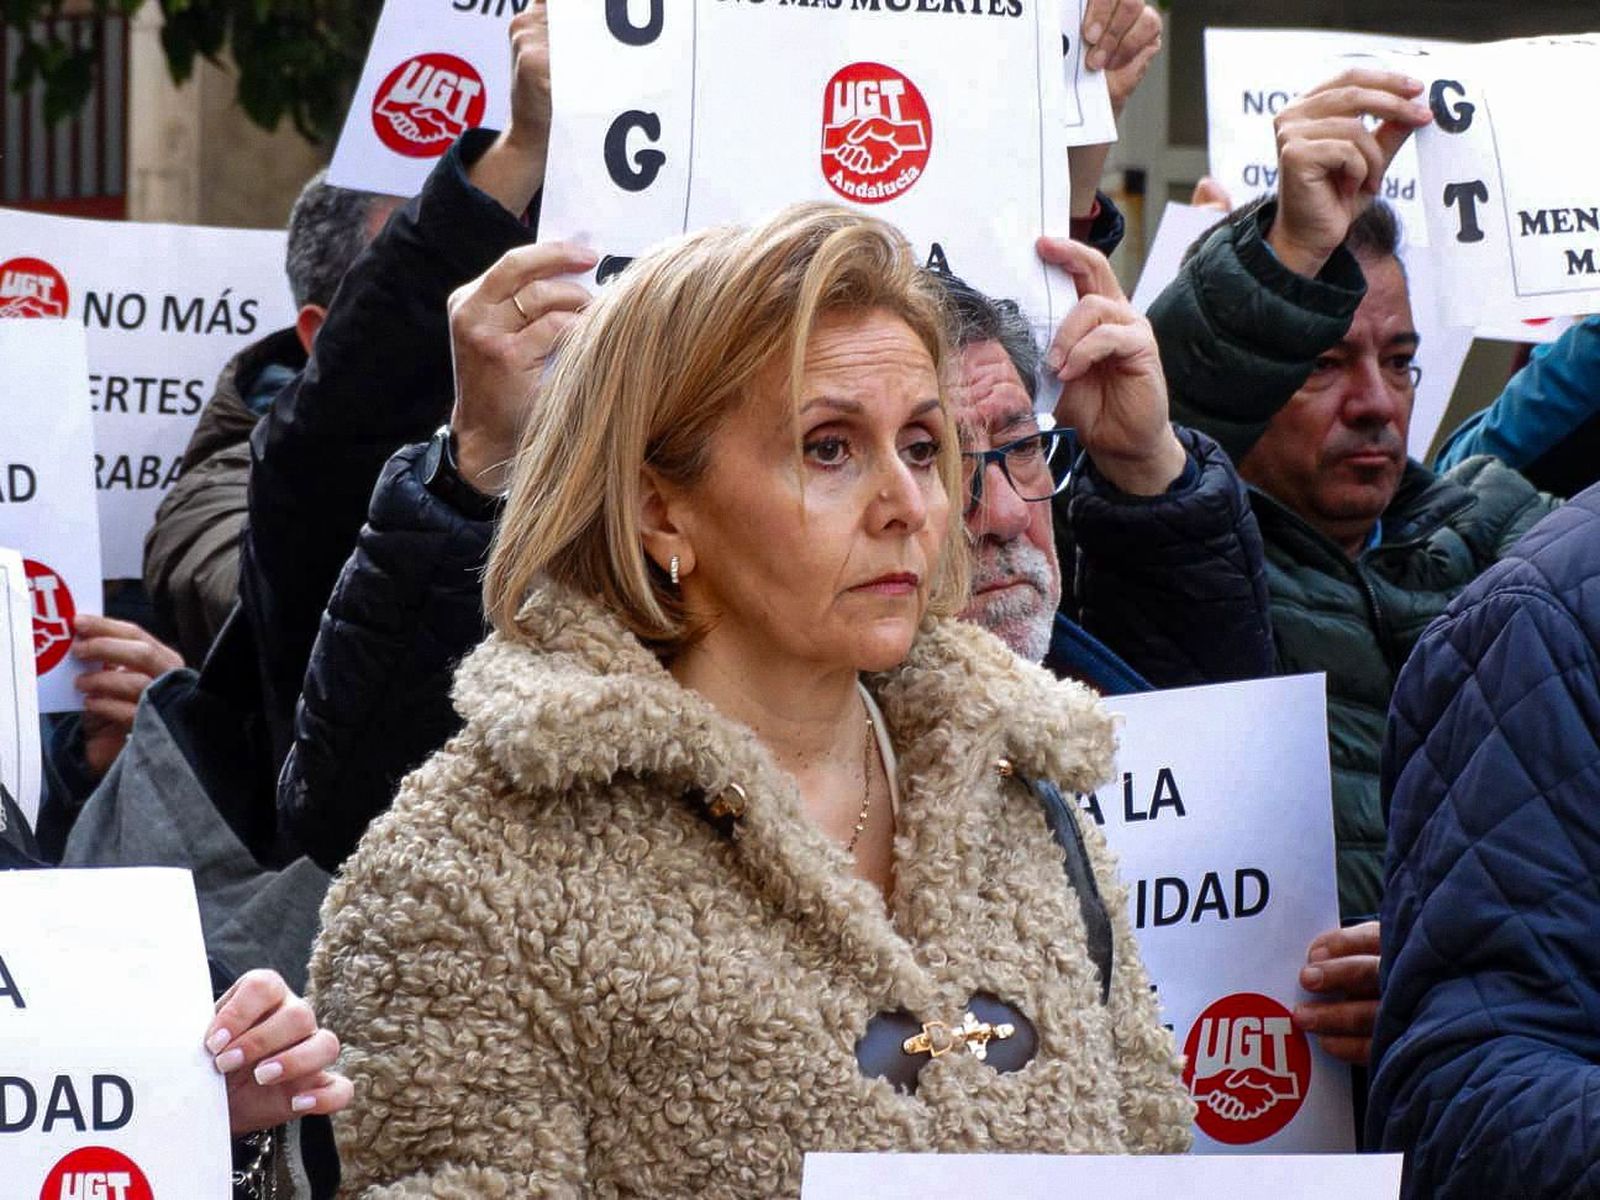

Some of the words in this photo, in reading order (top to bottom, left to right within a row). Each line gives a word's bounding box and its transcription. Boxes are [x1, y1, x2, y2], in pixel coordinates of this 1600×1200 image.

[389, 61, 480, 124] UGT
[832, 80, 905, 125] UGT
[1428, 78, 1476, 134] G
[604, 110, 666, 192] G
[829, 166, 920, 198] Andalucía
[1443, 179, 1488, 243] T
[0, 270, 55, 300] UGT
[1564, 248, 1600, 275] M
[84, 291, 146, 330] NO
[161, 287, 259, 335] MÁS
[1123, 767, 1186, 823] LA
[1136, 868, 1270, 929] IDAD
[1195, 1016, 1293, 1079] UGT
[0, 1074, 134, 1133] DAD
[59, 1172, 132, 1200] UGT
